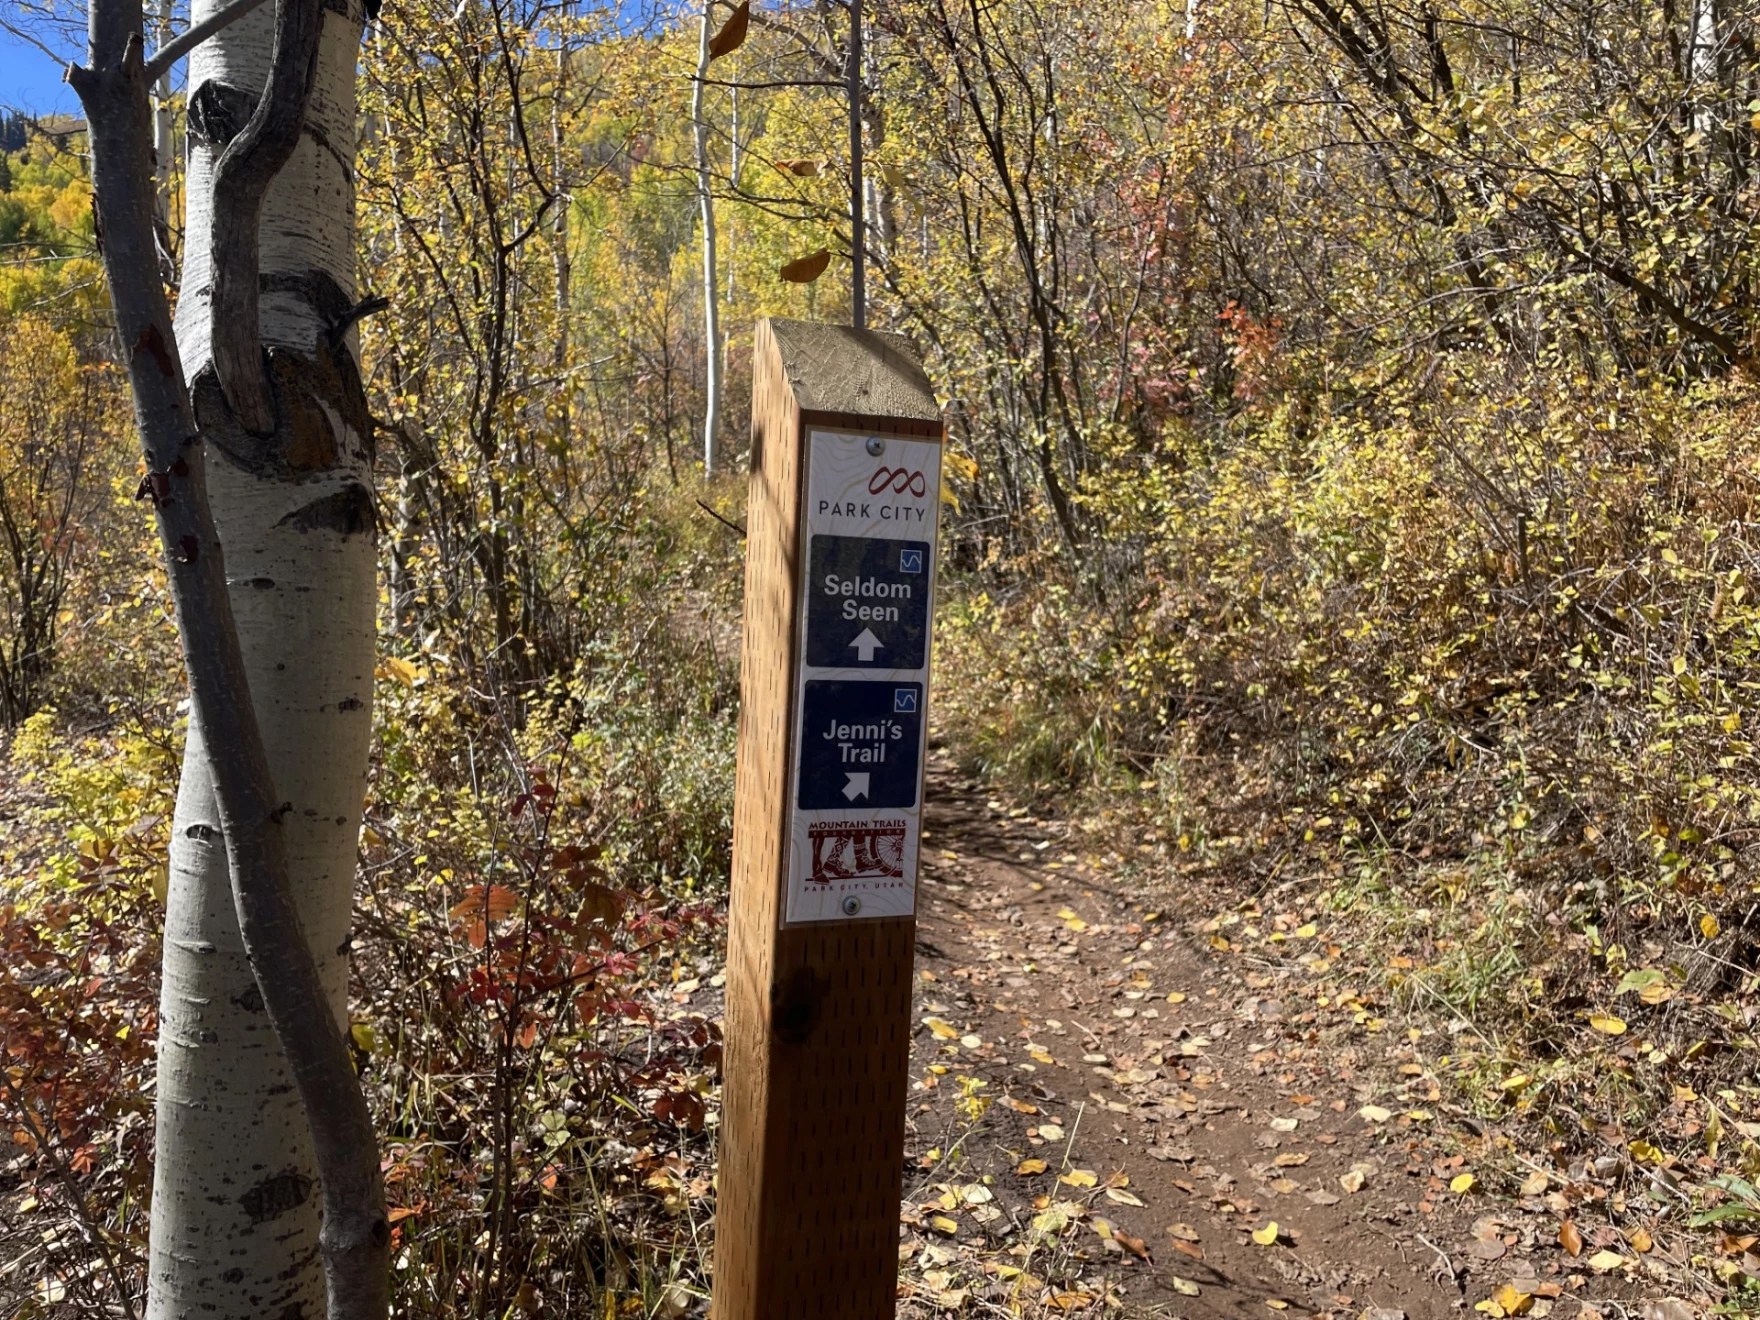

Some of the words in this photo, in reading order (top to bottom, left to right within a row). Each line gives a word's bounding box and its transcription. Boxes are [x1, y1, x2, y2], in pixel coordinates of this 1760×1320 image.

[819, 500, 870, 518] PARK
[880, 505, 925, 521] CITY
[824, 574, 911, 598] Seldom
[842, 599, 898, 621] Seen
[838, 743, 886, 762] Trail
[808, 820, 868, 829] MOUNTAIN
[873, 819, 906, 828] TRAILS
